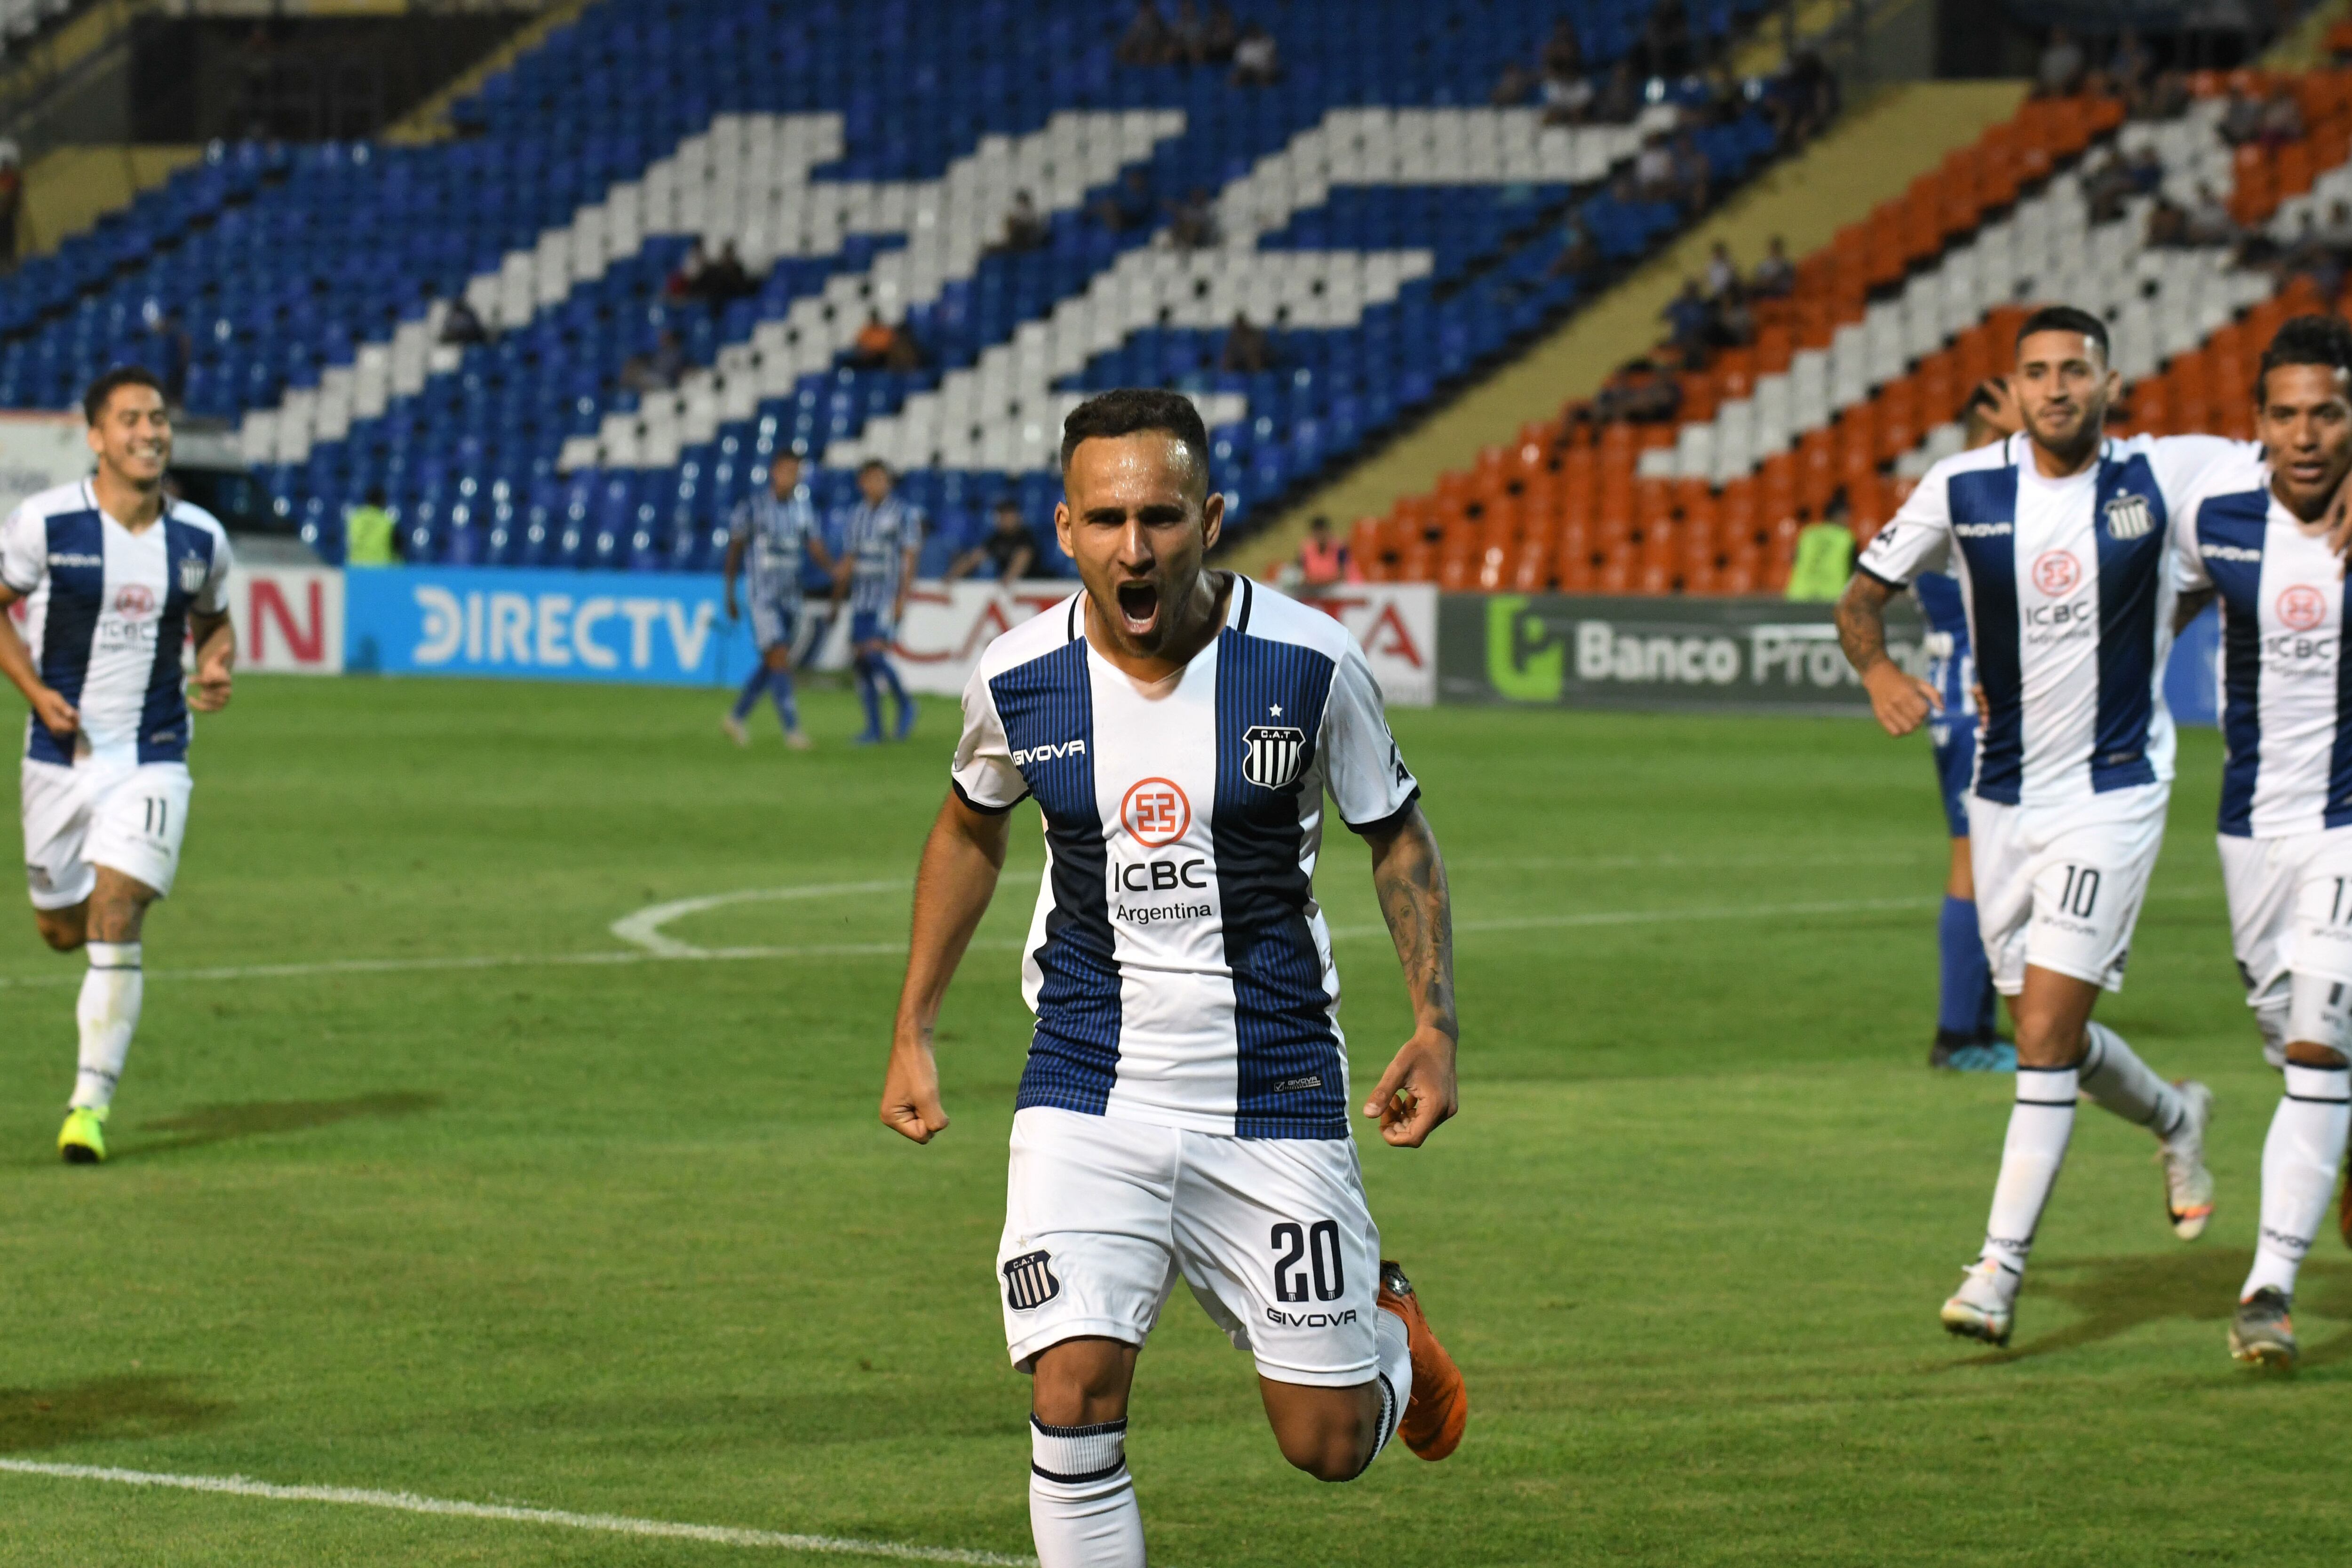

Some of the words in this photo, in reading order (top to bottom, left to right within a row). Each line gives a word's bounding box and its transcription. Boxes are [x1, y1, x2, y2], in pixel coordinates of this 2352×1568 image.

[413, 584, 716, 671] DIRECTV
[2026, 601, 2090, 627] ICBC
[1576, 621, 1740, 685] Banco
[1013, 740, 1085, 766] GIVOVA
[144, 797, 167, 837] 11
[1115, 859, 1207, 892] ICBC
[2059, 865, 2100, 918] 10
[1116, 902, 1212, 925] Argentina
[1288, 1076, 1317, 1085] GIVOVA
[1271, 1220, 1344, 1302] 20
[1267, 1307, 1357, 1327] GIVOVA
